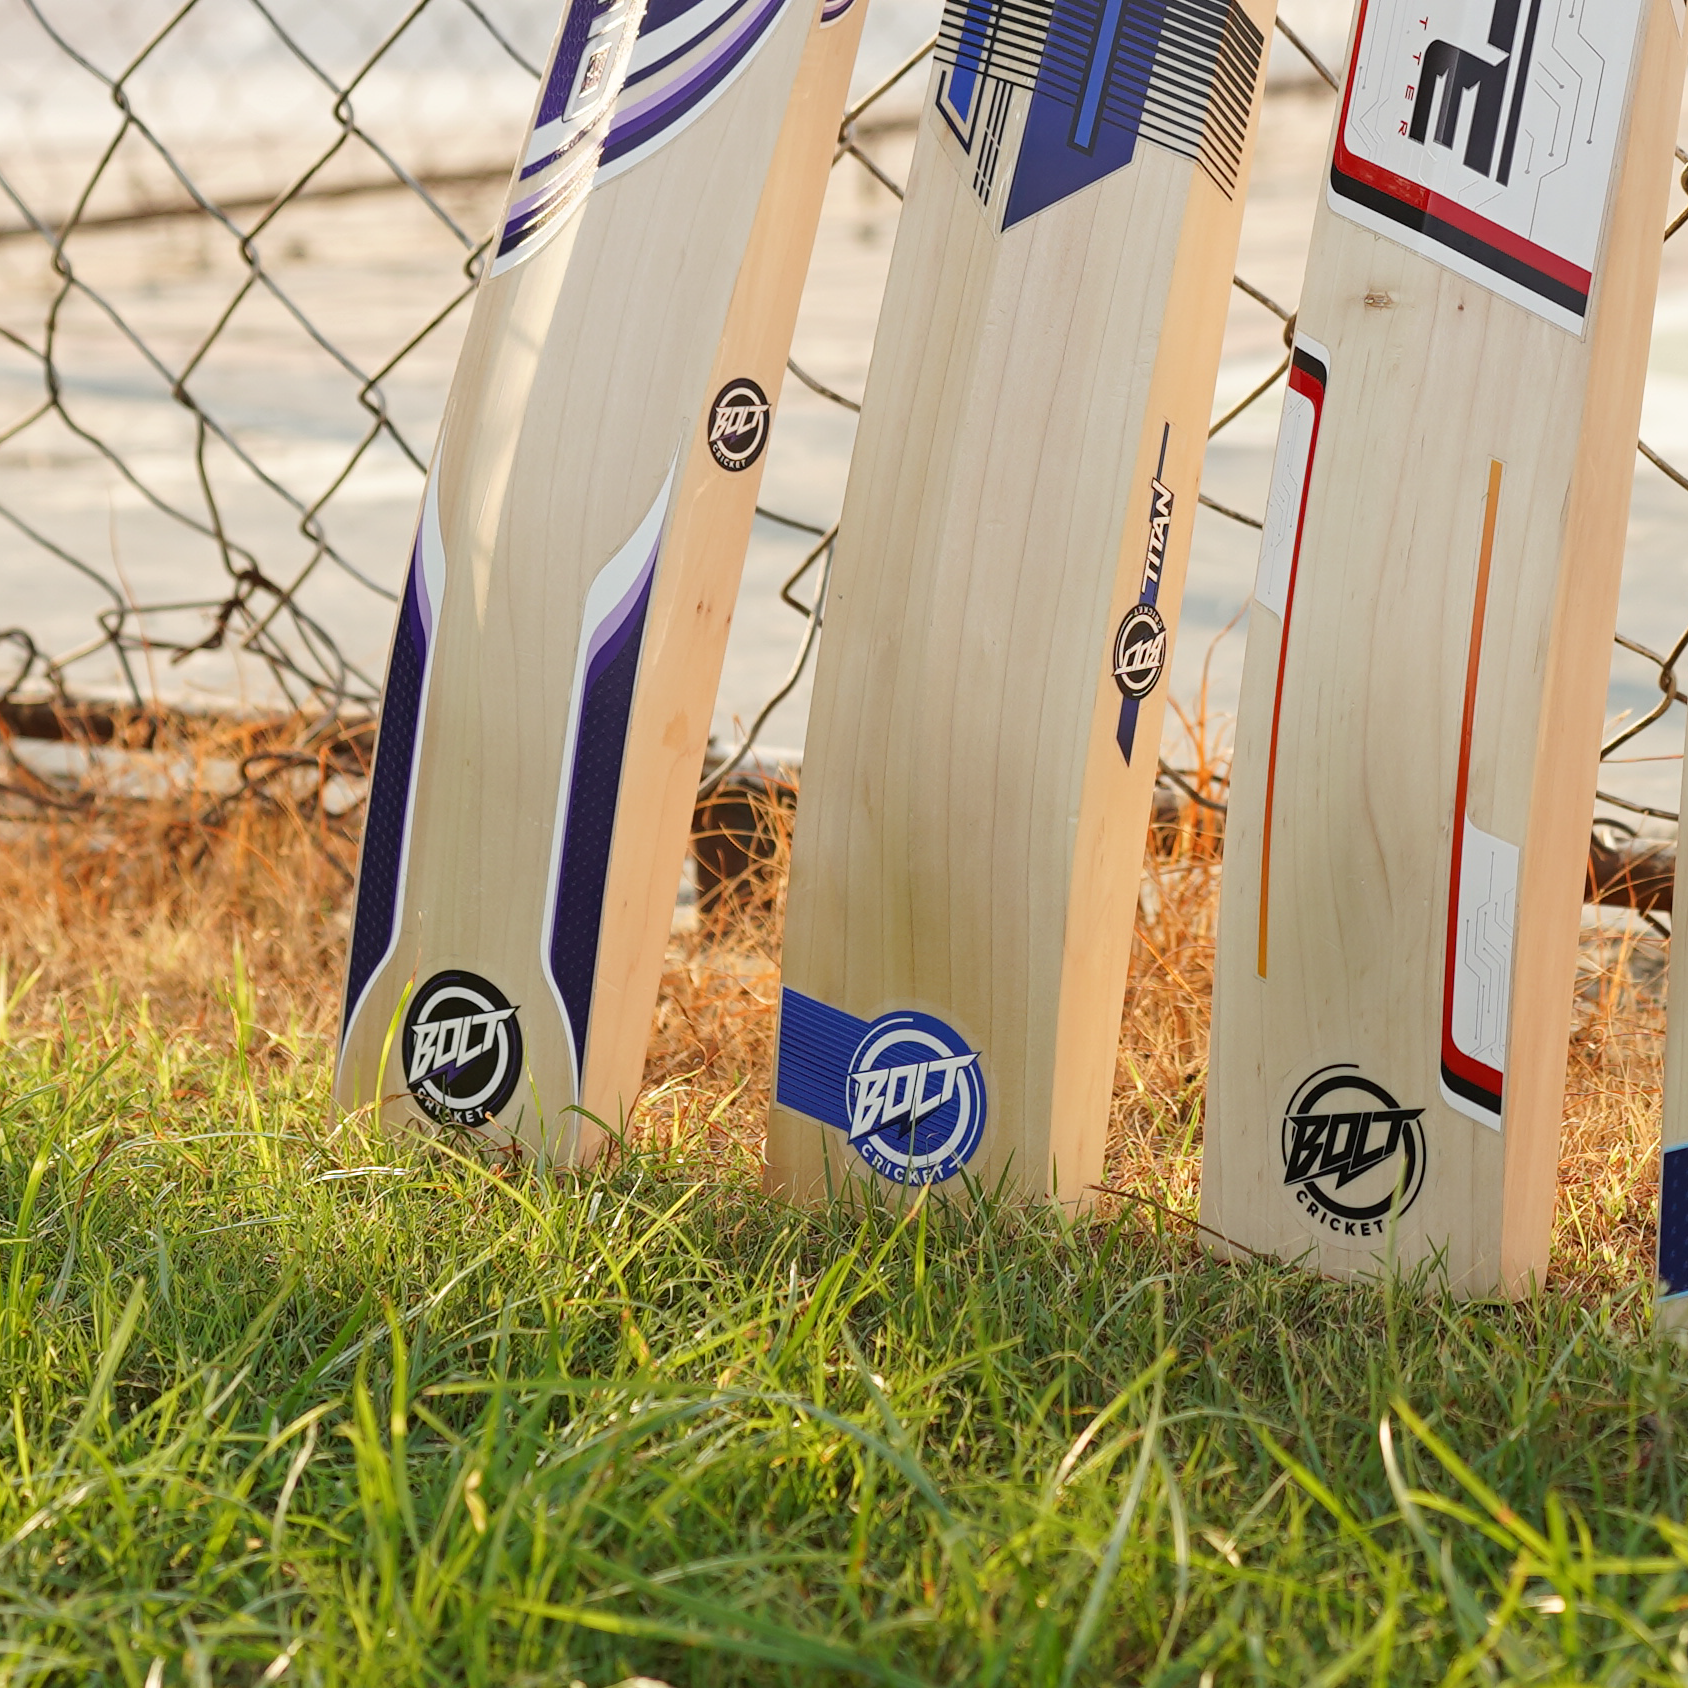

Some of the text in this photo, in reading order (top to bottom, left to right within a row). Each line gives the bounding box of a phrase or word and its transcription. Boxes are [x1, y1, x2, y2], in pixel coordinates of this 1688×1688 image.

[709, 404, 771, 442] BOLT
[713, 444, 747, 469] CRICKET
[1141, 478, 1174, 594] TITAN
[1111, 628, 1167, 676] BOLT
[408, 1007, 519, 1086] BOLT
[848, 1052, 982, 1143] BOLT
[1284, 1108, 1426, 1185] BOLT
[1296, 1190, 1383, 1236] CRICKET
